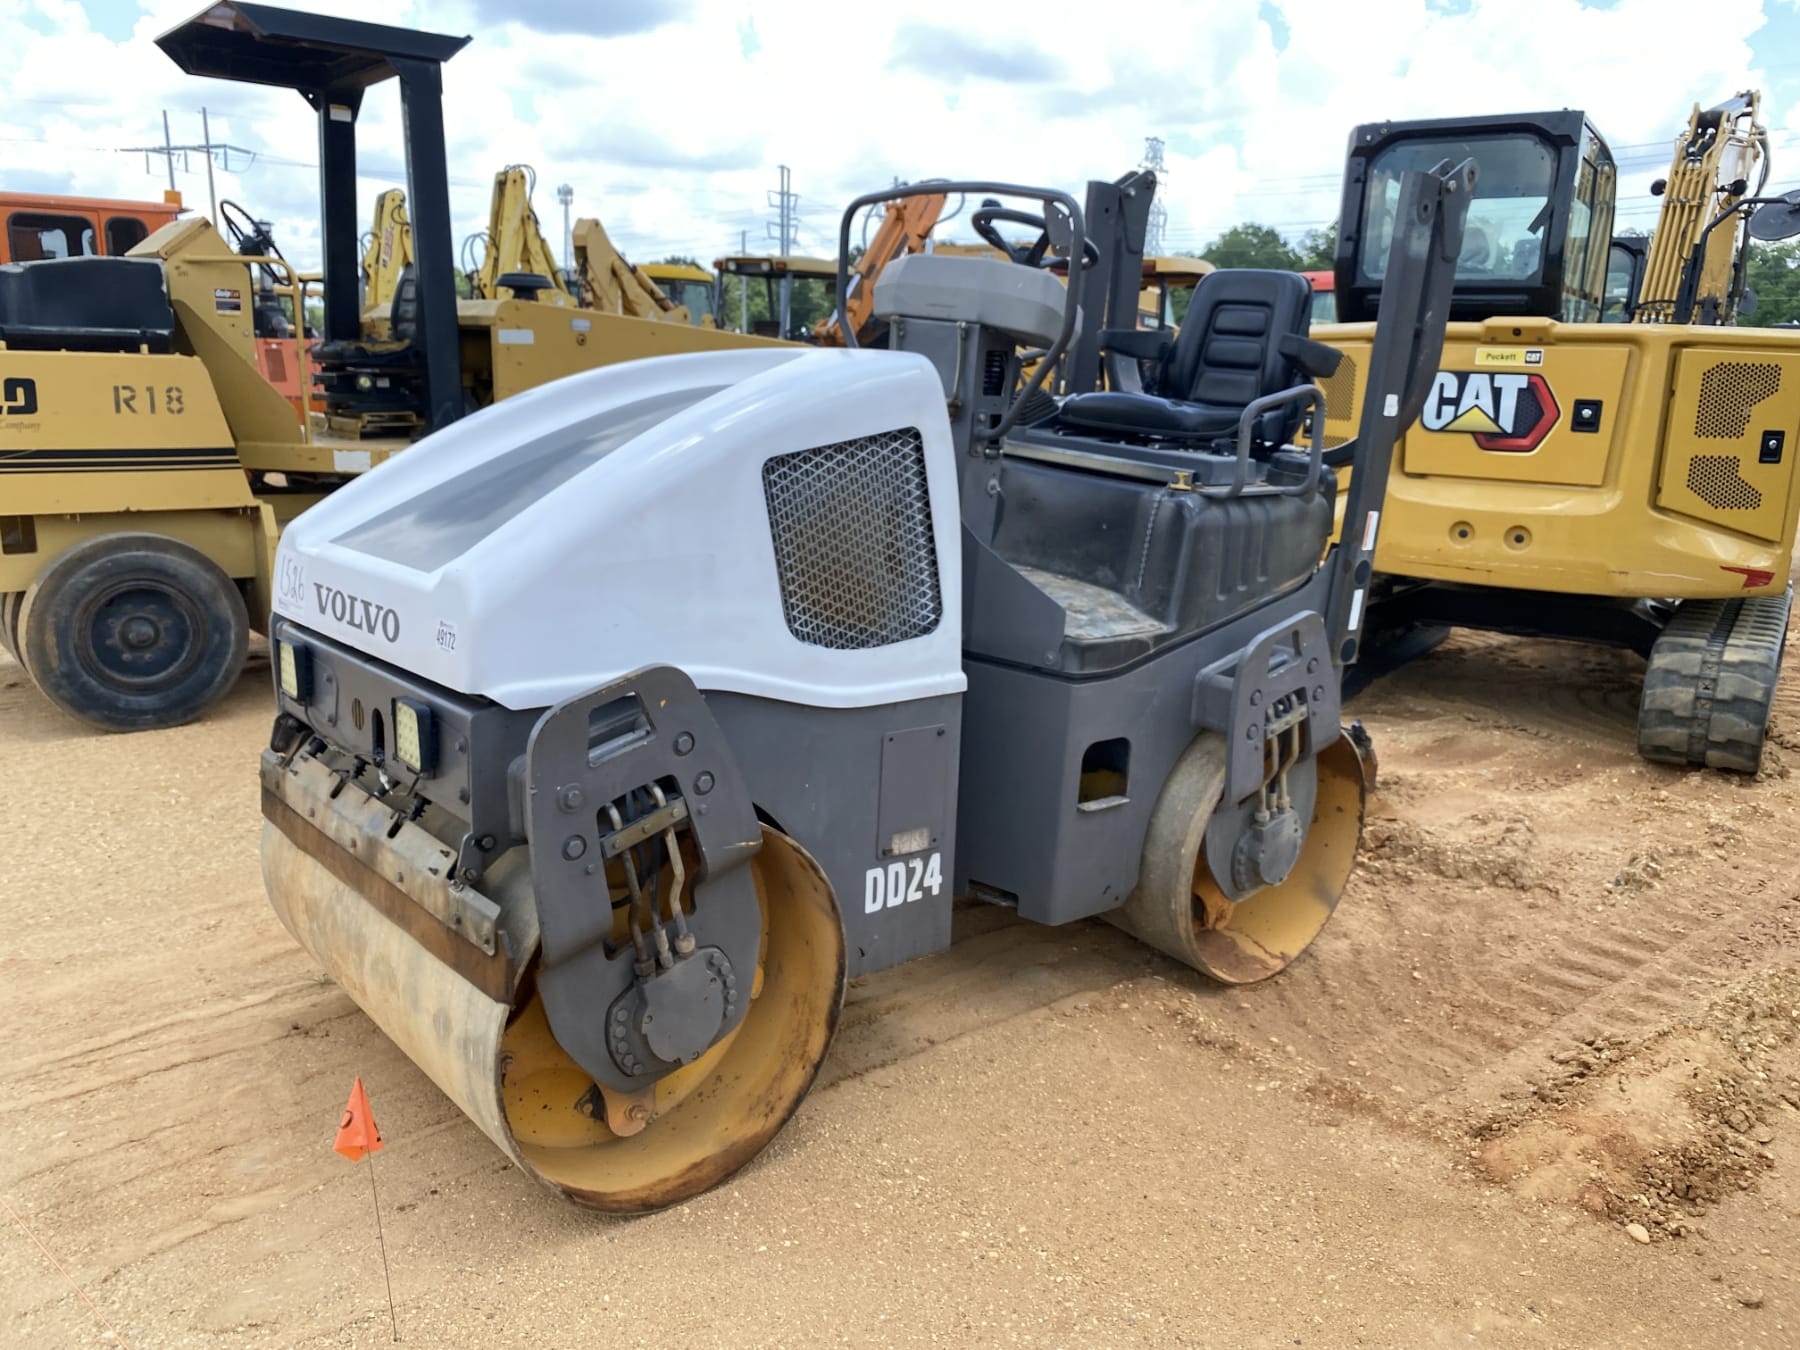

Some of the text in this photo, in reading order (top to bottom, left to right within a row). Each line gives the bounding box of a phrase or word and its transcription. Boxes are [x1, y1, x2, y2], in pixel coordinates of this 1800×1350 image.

[113, 385, 185, 415] R18
[1422, 371, 1529, 434] CAT
[313, 582, 400, 643] VOLVO
[436, 628, 456, 650] 49172
[864, 852, 943, 914] DD24
